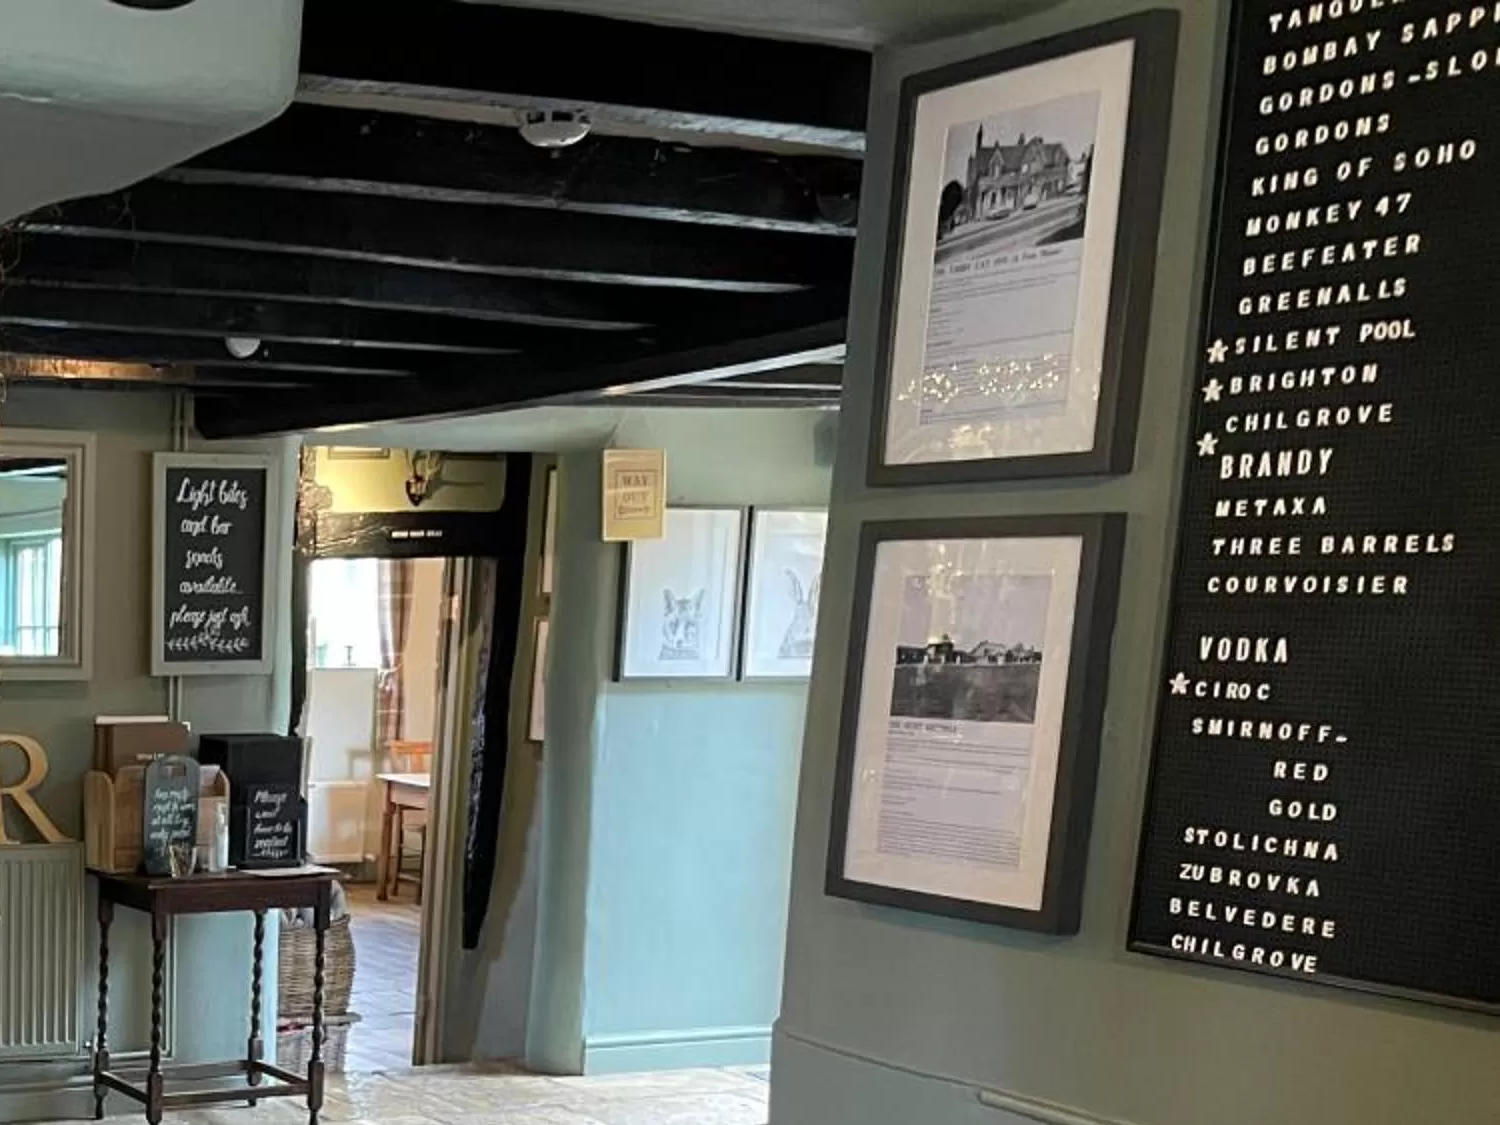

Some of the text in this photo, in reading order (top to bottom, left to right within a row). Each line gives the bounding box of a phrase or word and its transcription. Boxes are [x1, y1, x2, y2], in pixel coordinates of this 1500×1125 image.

[1264, 30, 1381, 75] BOMBAY
[1260, 48, 1500, 115] GORDONS -SLO
[1256, 113, 1390, 155] GORDONS
[1252, 140, 1475, 196] KING OF SOHO
[1246, 193, 1411, 236] MONKEY 47
[1244, 232, 1420, 276] BEEFEATER
[1239, 278, 1405, 314] GREENALLS
[1236, 320, 1415, 354] SILENT POOL
[1230, 364, 1377, 394] BRIGHTON
[1226, 404, 1392, 432] CHILGROVE
[1220, 448, 1332, 479] BRANDY
[177, 477, 215, 510] Light
[1216, 497, 1325, 516] METAXA
[1213, 534, 1454, 555] THREE BARRELS
[1208, 576, 1407, 594] COURVOISIER
[1201, 636, 1287, 662] VODKA
[1196, 681, 1270, 700] CIROC
[1274, 761, 1328, 781] RED
[1269, 799, 1336, 820] GOLD
[1184, 827, 1337, 860] STOLICHNA
[1180, 864, 1319, 896] ZUBROVKA
[1170, 898, 1334, 940] BELVEDERE
[1172, 934, 1316, 972] CHILGROVE
